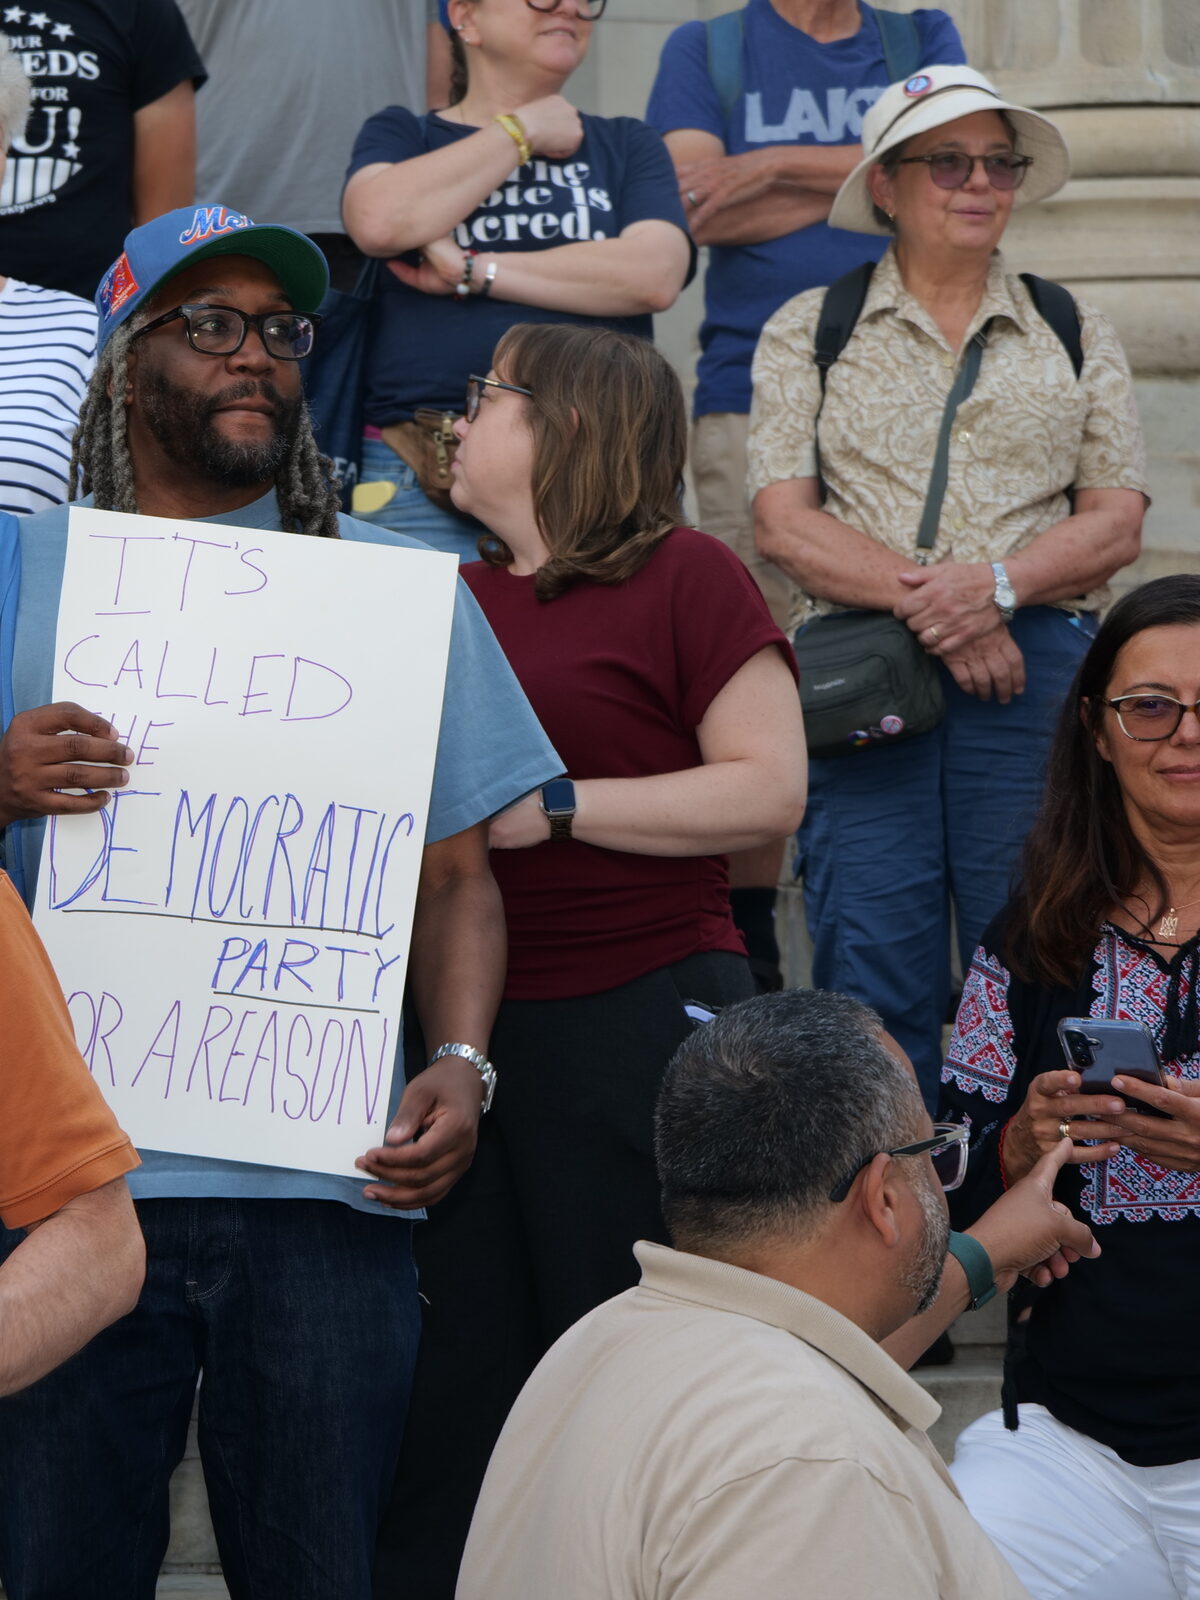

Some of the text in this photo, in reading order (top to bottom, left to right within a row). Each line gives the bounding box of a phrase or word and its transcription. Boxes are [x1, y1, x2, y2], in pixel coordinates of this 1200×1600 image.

[30, 85, 69, 101] FOR
[568, 179, 613, 213] is
[89, 531, 268, 616] IT'S
[63, 634, 353, 721] CALLED
[48, 787, 415, 939] DEMOCRATIC
[211, 936, 401, 1003] PARTY
[130, 999, 181, 1100] A
